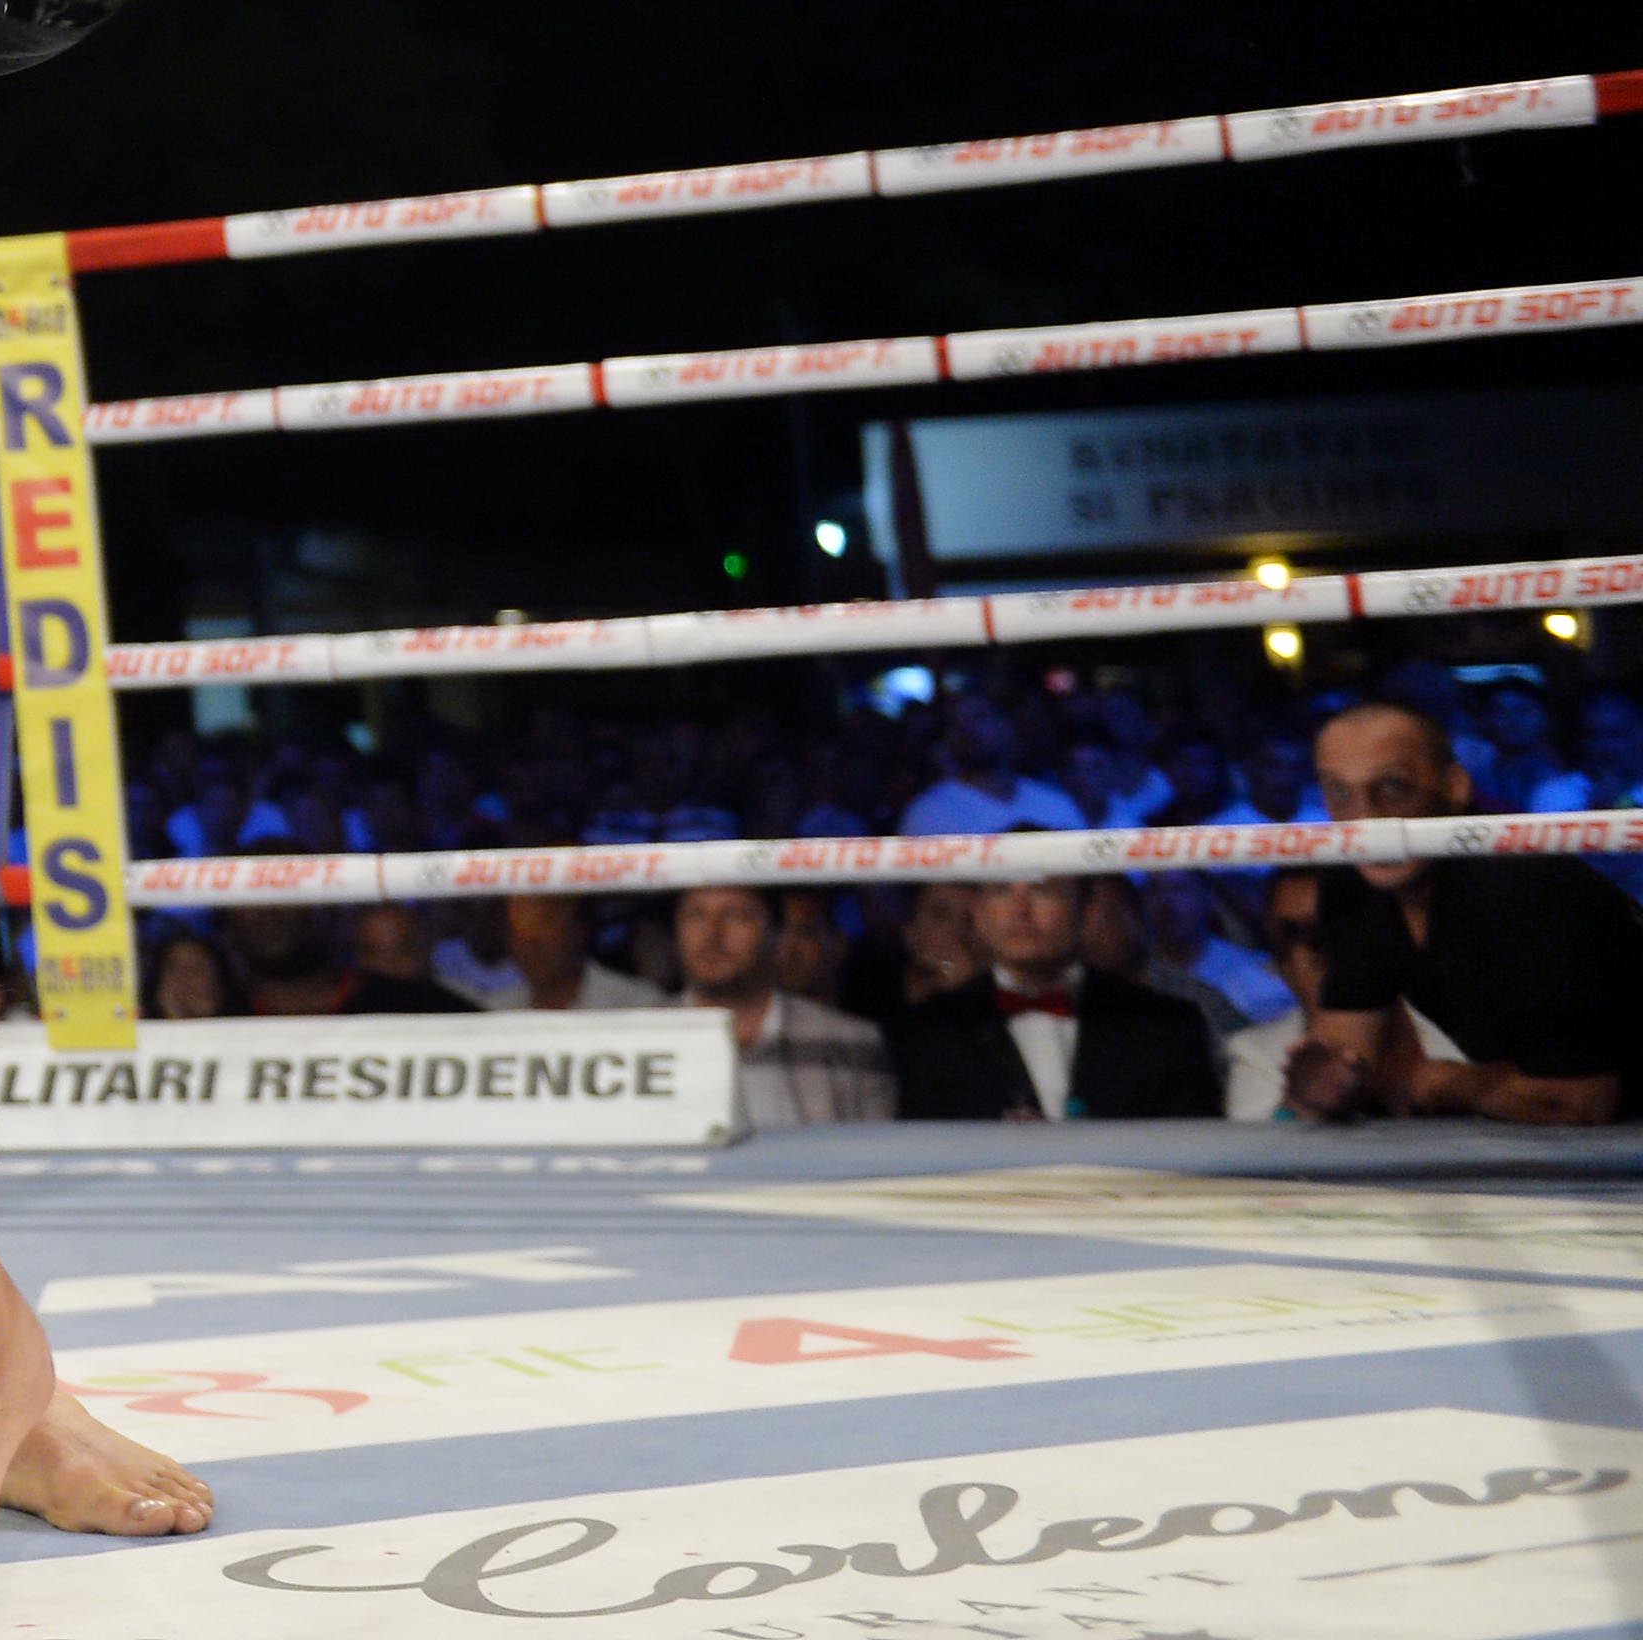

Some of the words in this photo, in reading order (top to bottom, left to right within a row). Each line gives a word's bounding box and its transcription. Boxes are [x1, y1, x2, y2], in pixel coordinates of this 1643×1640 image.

[0, 361, 109, 932] REDIS
[245, 1051, 680, 1102] RESIDENCE
[726, 1315, 1036, 1365] 4
[221, 1465, 1629, 1619] Corleone
[704, 1568, 1238, 1640] URANT
